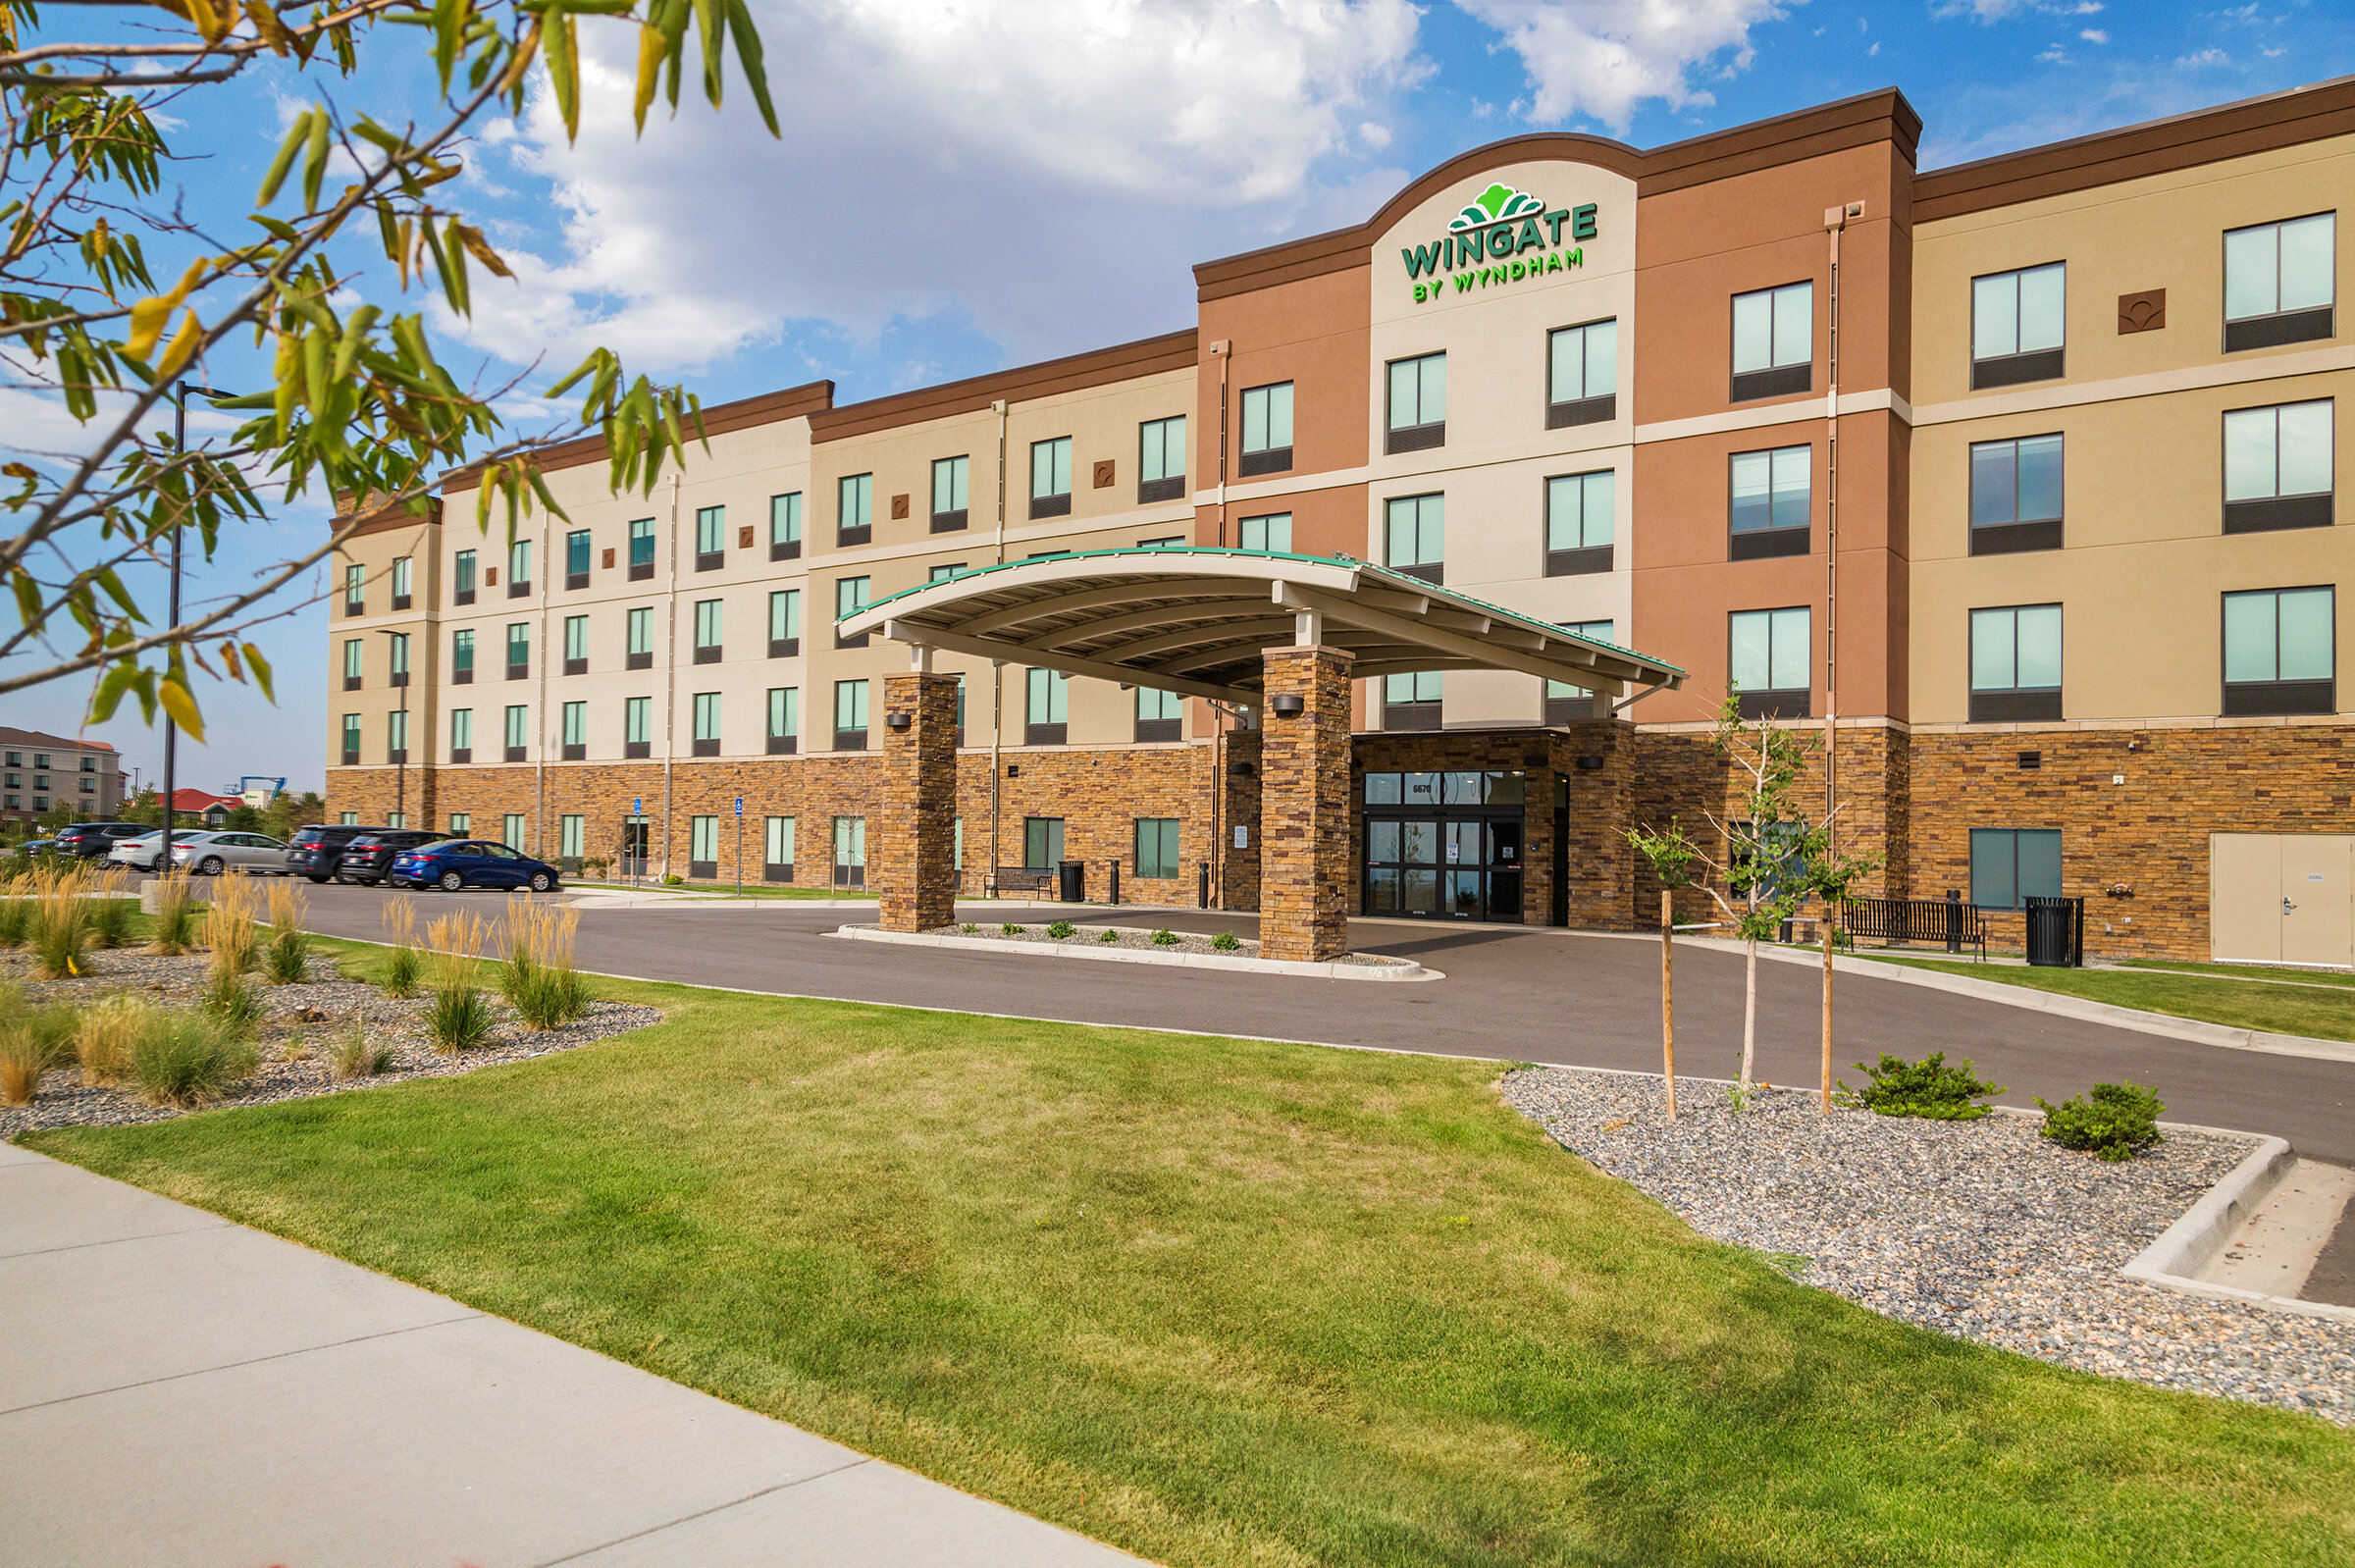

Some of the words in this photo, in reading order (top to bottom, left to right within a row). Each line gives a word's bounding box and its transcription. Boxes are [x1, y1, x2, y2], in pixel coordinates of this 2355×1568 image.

[1401, 203, 1596, 278] WINGATE
[1413, 280, 1442, 303] BY
[1453, 247, 1583, 292] WYNDHAM
[1413, 784, 1432, 793] 6670
